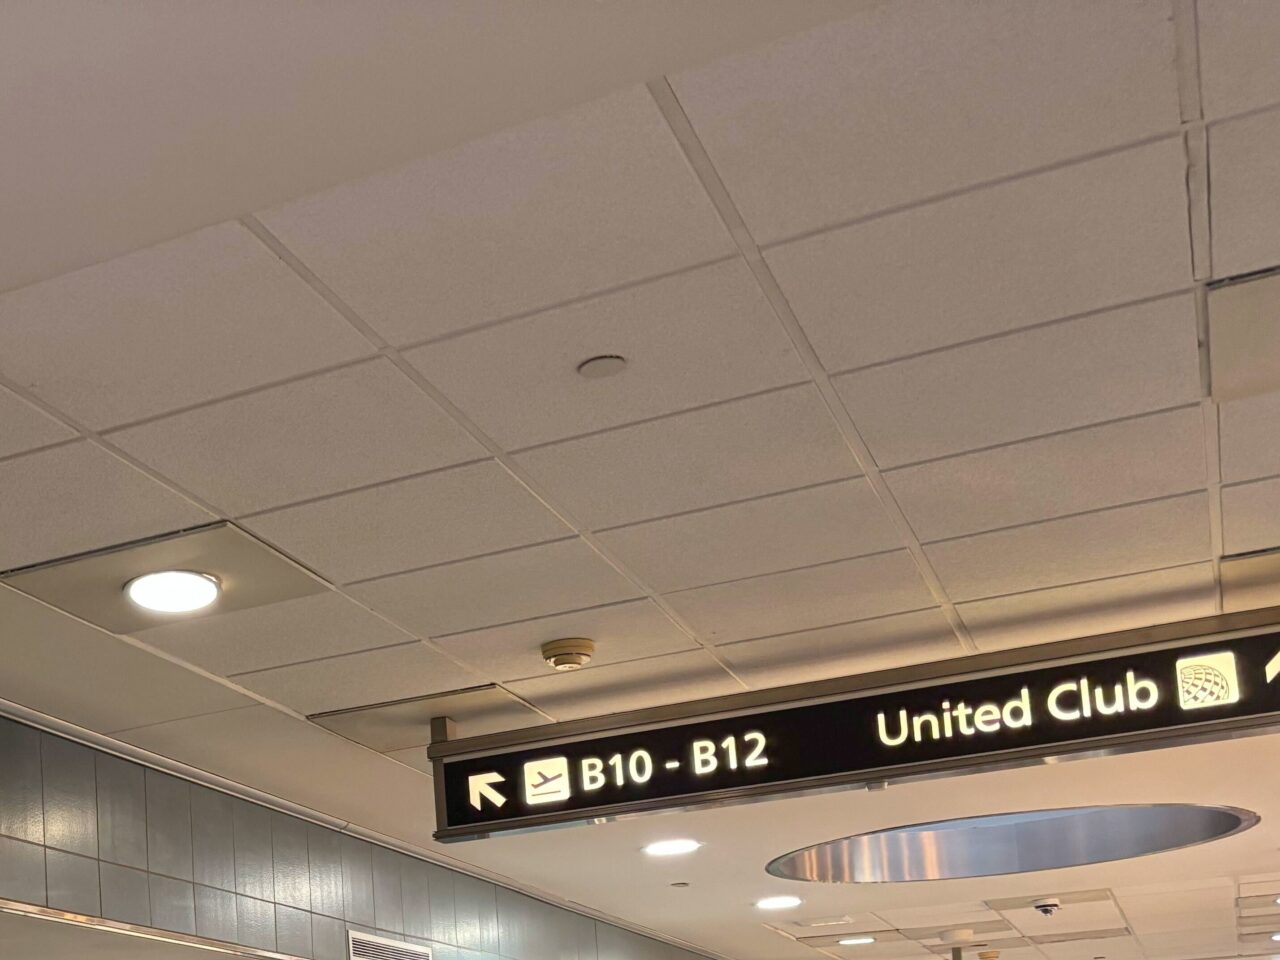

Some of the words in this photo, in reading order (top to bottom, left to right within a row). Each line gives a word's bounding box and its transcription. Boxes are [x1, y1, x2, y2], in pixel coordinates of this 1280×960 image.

[876, 696, 1034, 747] United
[1045, 670, 1160, 723] Club
[582, 749, 653, 794] B10
[692, 732, 769, 774] B12
